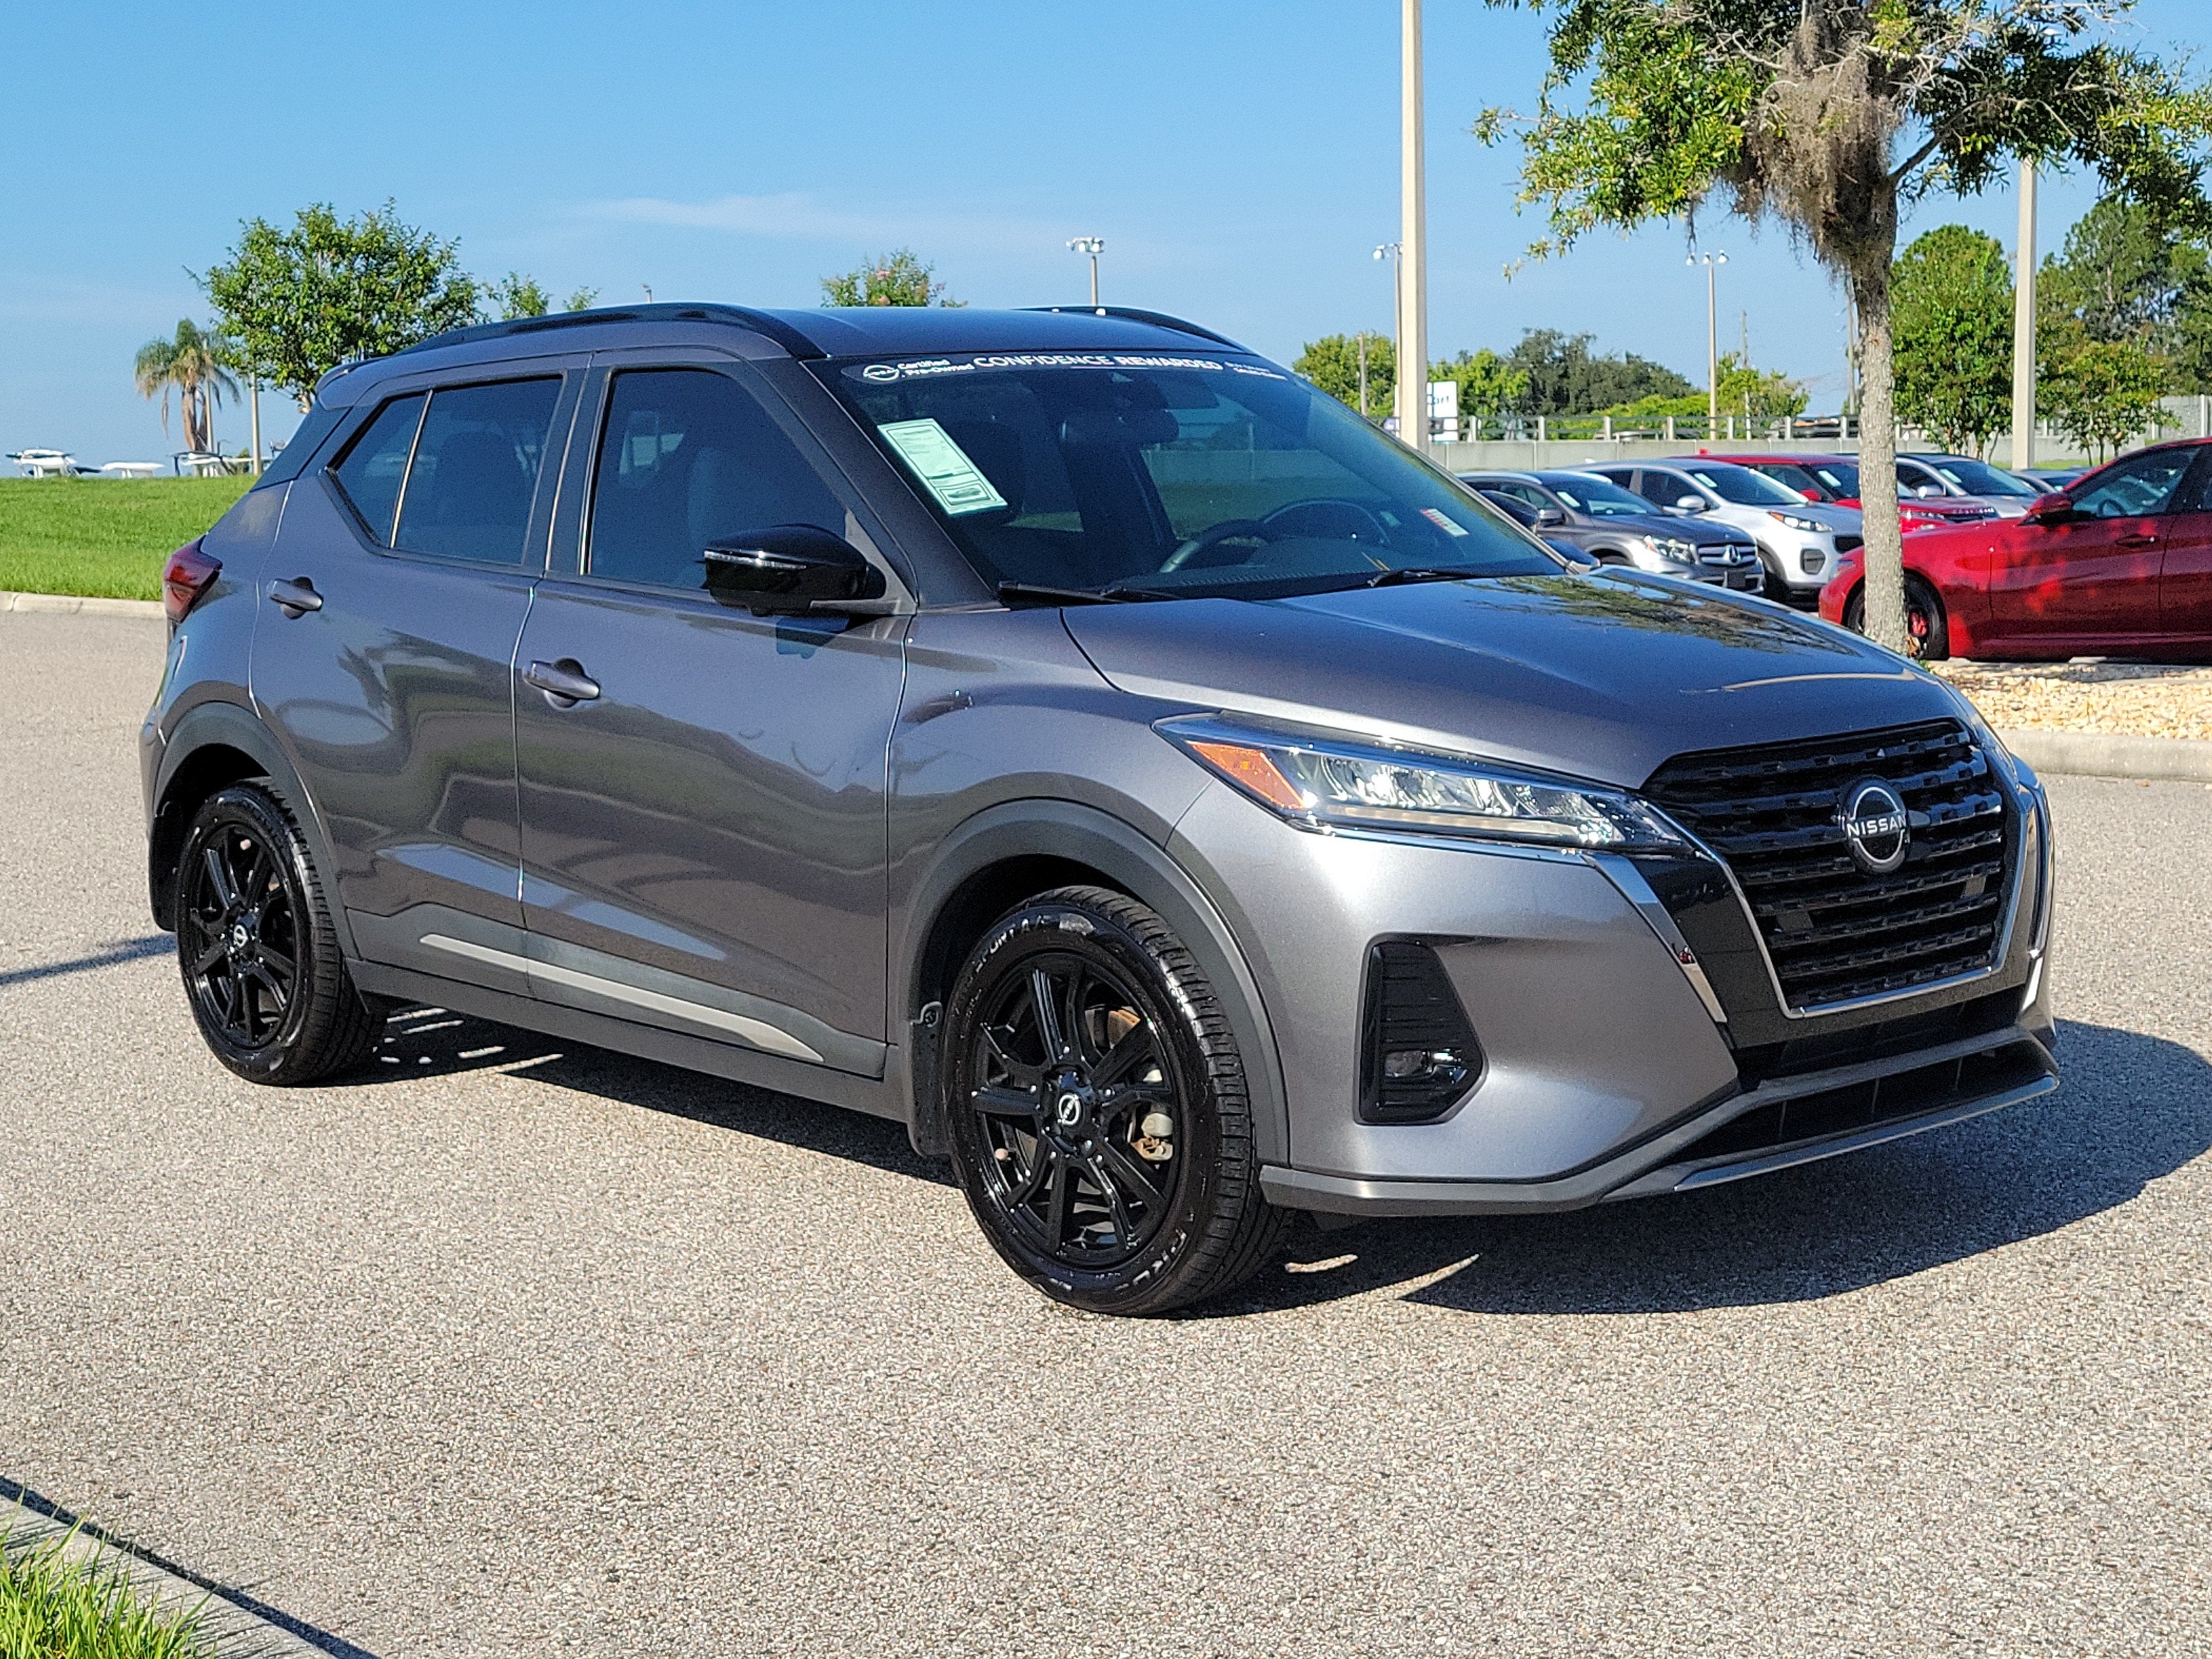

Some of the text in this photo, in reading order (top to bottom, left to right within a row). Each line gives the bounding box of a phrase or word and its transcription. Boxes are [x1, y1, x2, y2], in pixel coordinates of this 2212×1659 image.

[973, 355, 1115, 367] CONFIDENCE
[1113, 356, 1224, 370] REWARDED
[1846, 814, 1906, 837] NISSAN
